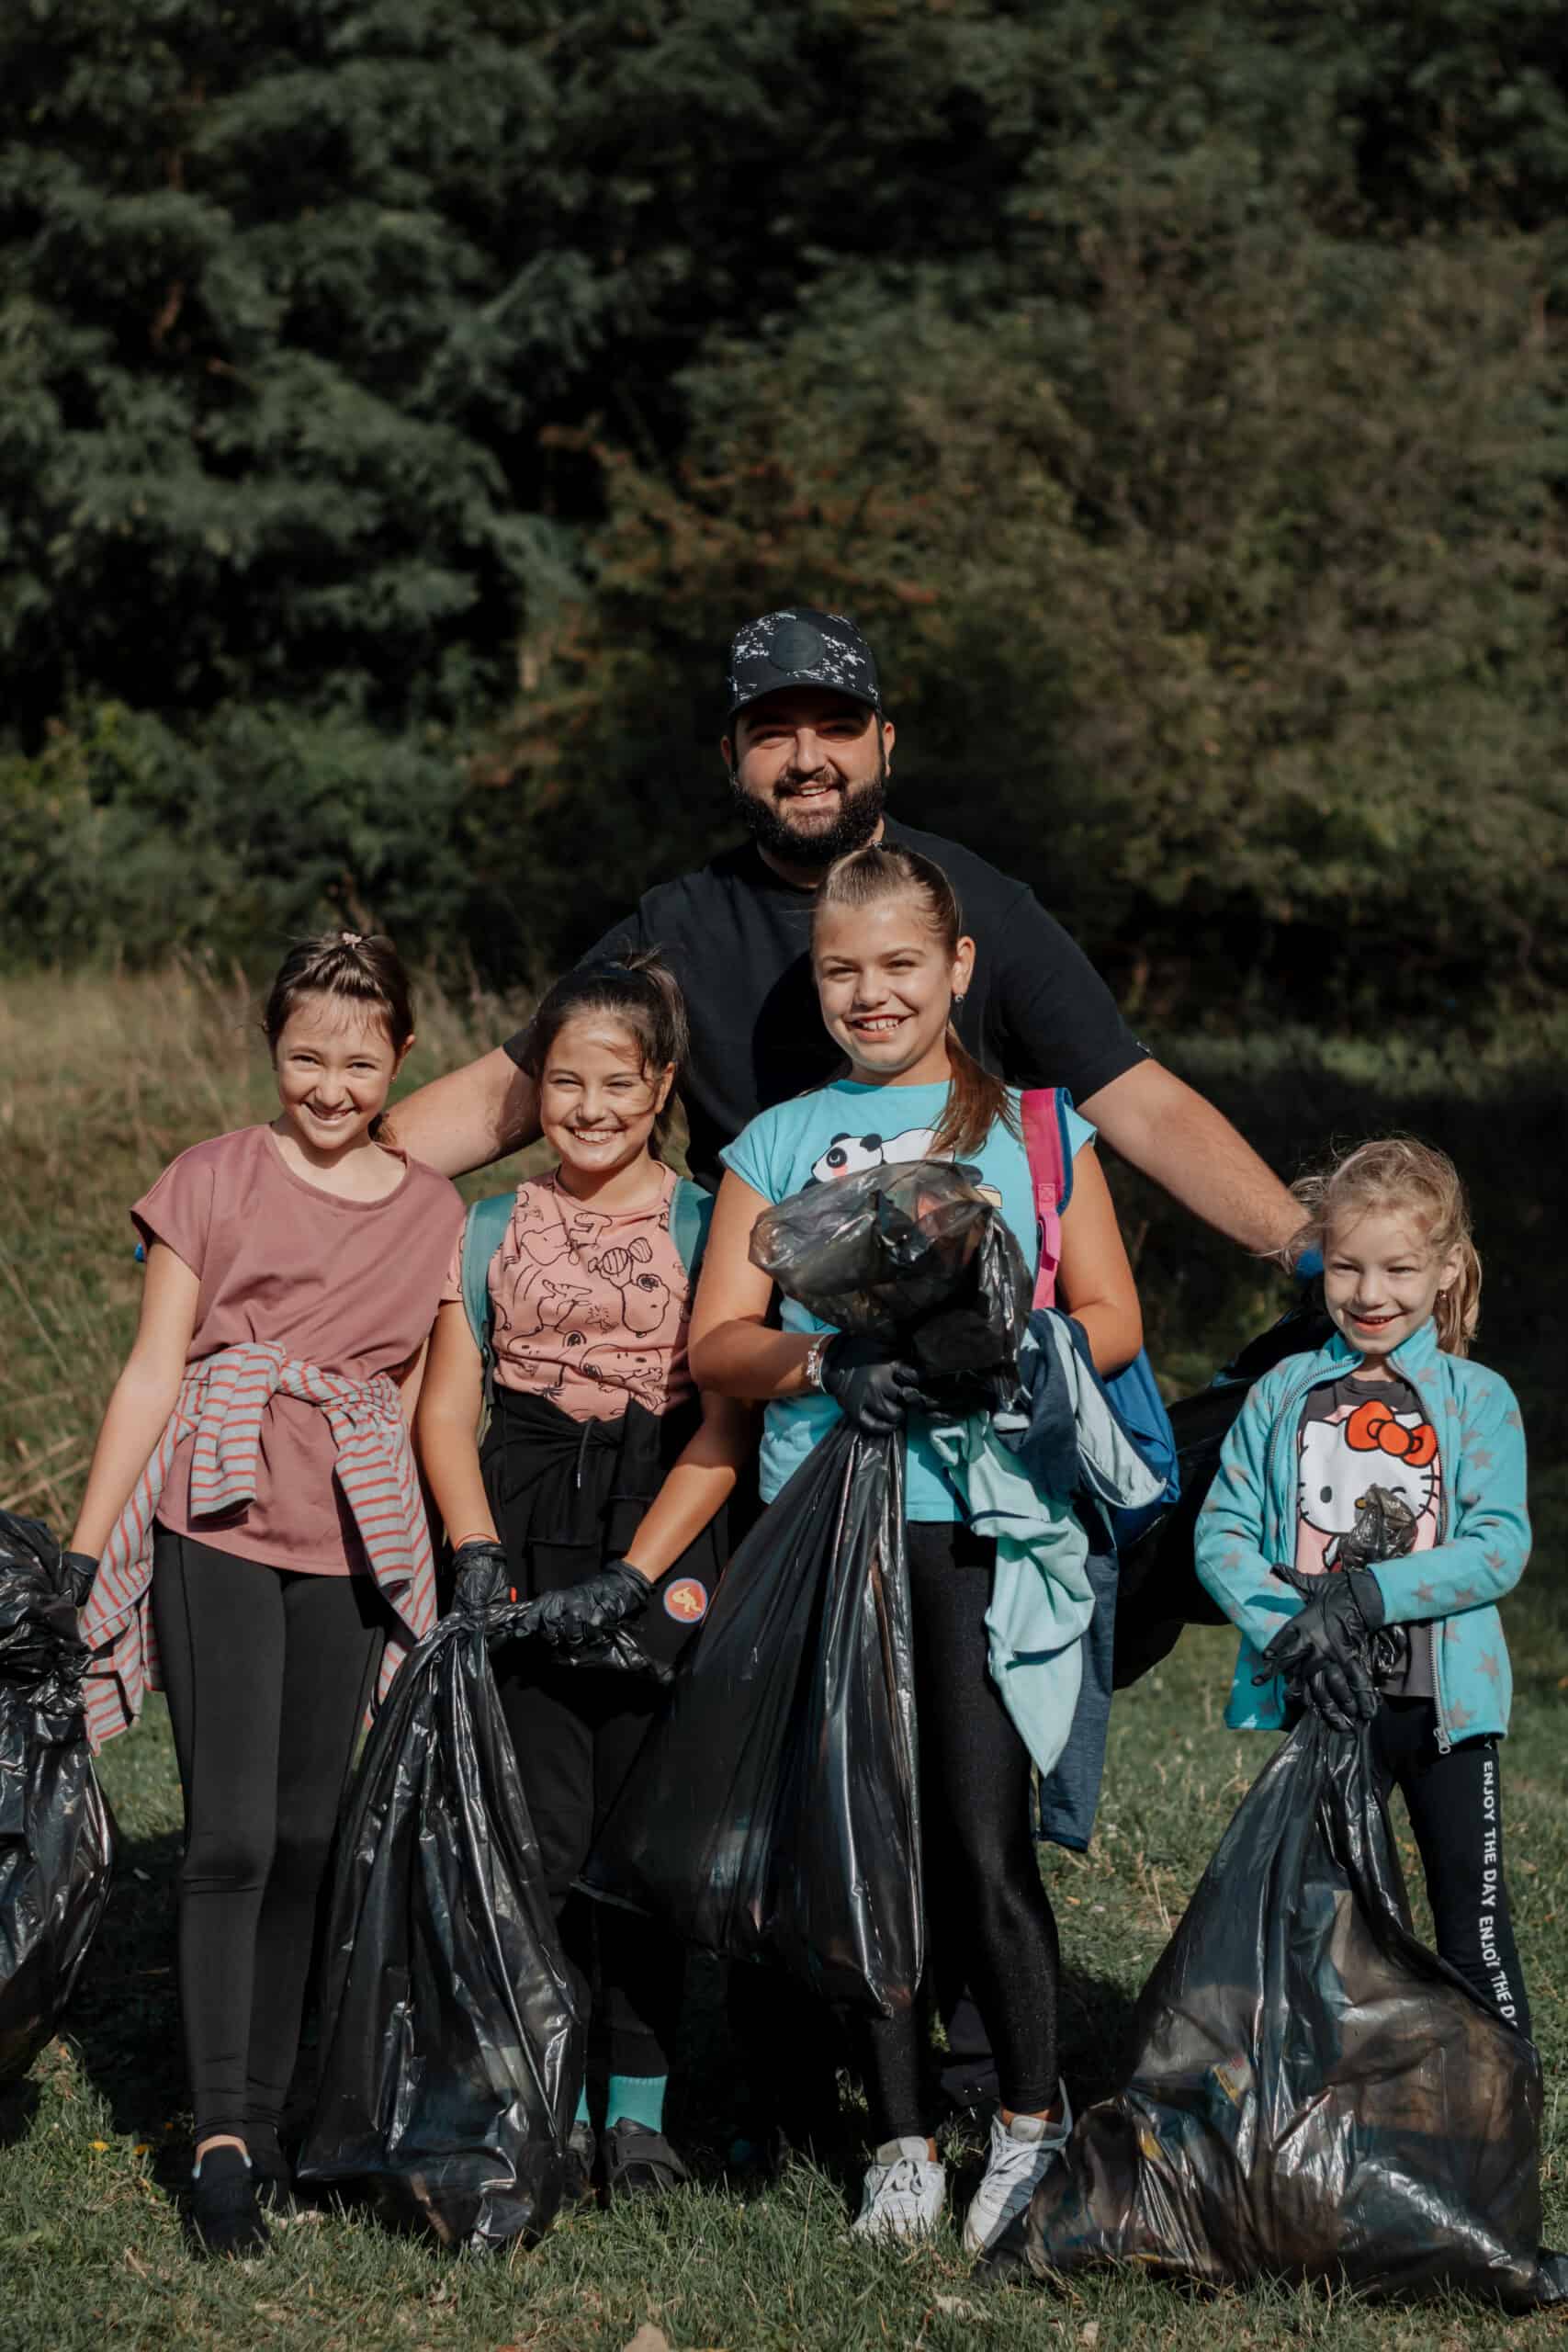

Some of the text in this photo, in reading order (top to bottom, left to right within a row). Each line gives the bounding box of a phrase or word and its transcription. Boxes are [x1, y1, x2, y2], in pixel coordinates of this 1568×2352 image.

[1483, 1760, 1495, 1822] ENJOY
[1483, 1826, 1497, 1865] THE
[1481, 1868, 1497, 1907] DAY
[1491, 1970, 1513, 2002] THE
